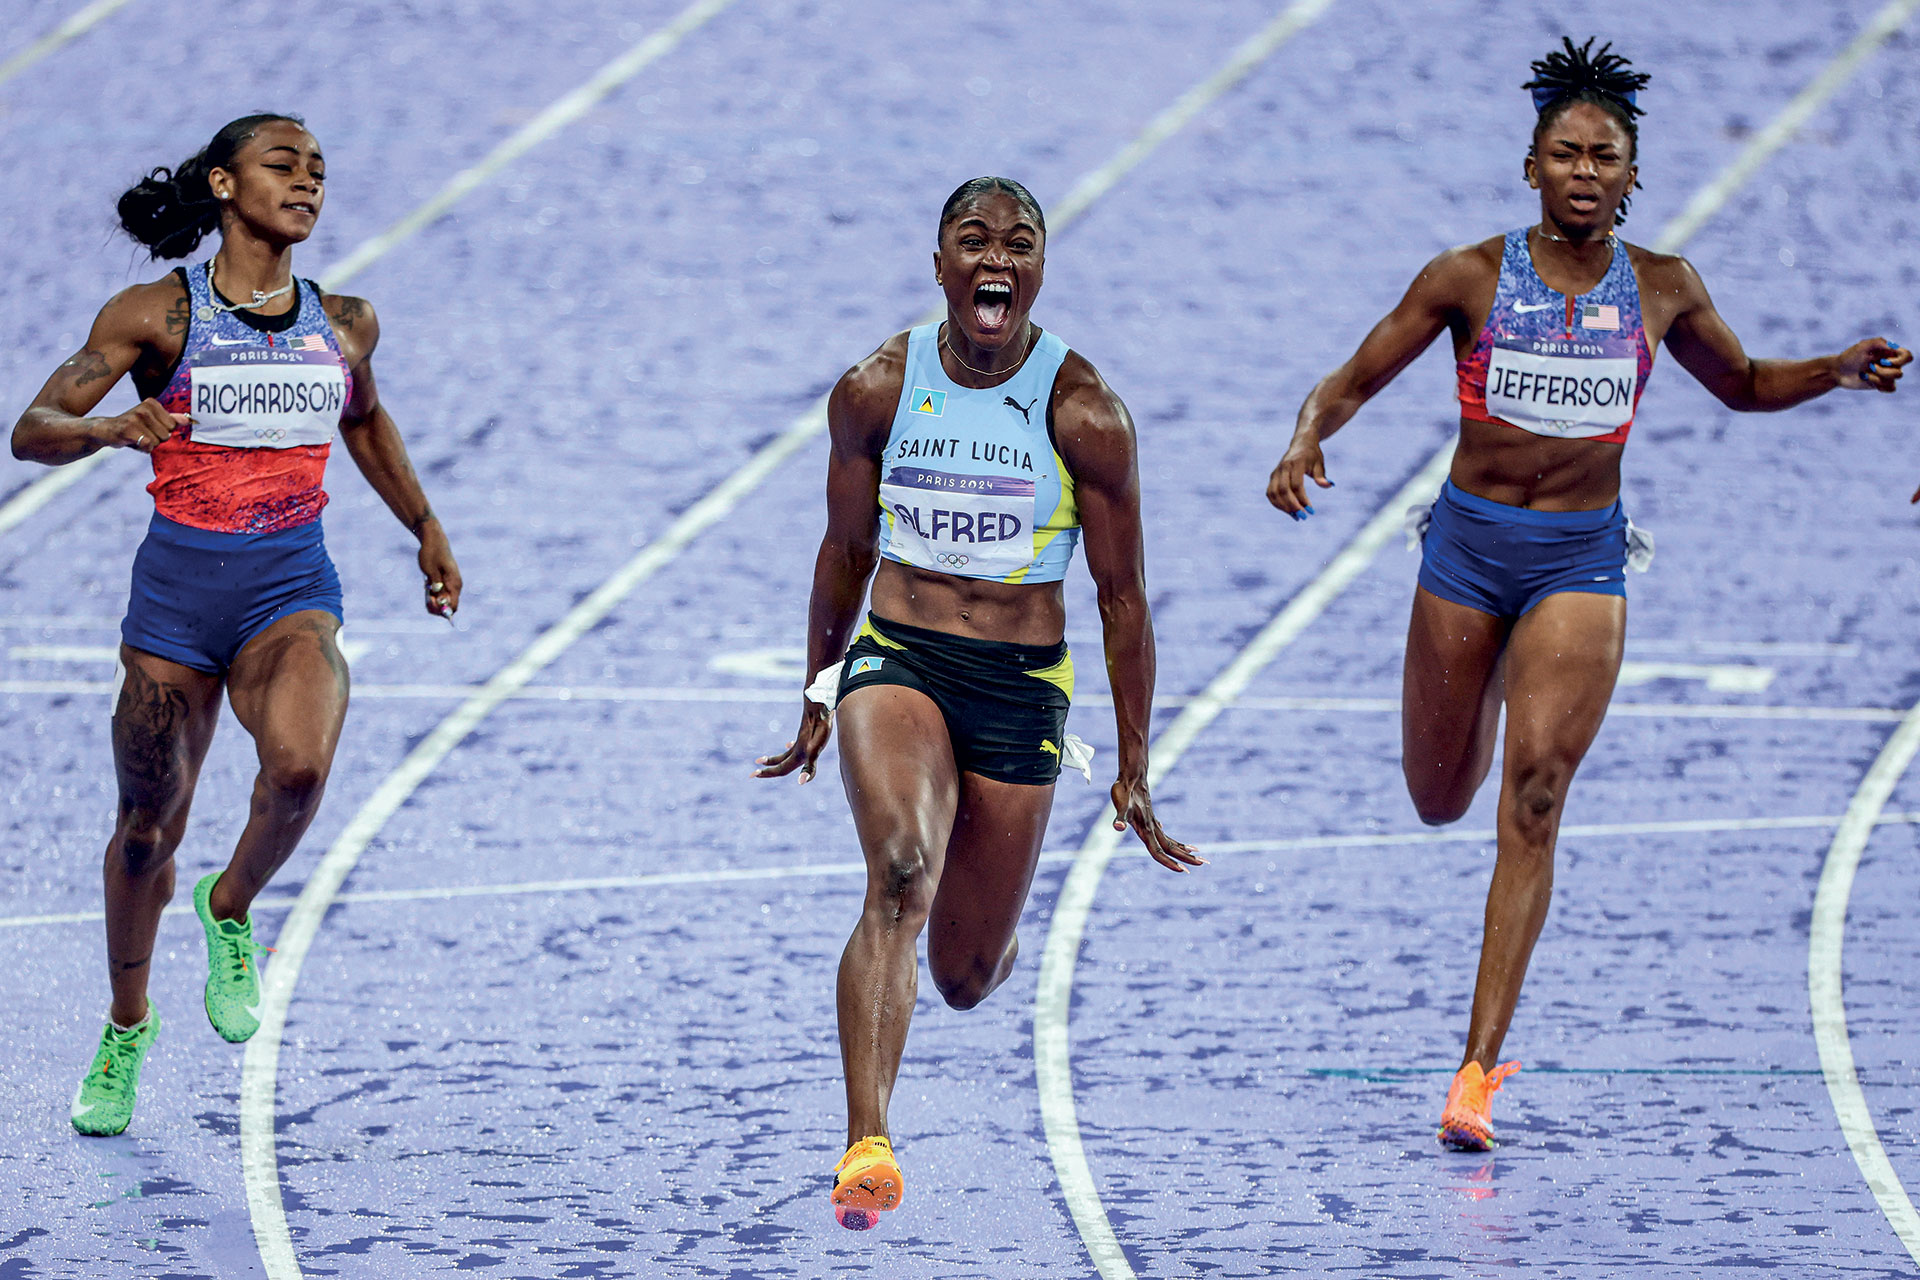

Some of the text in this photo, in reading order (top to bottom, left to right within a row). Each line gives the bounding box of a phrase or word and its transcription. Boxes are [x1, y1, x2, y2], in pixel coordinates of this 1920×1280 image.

[230, 350, 304, 362] PARIS 2024
[1532, 341, 1604, 356] PARIS 2024
[197, 381, 341, 415] RICHARDSON
[1491, 367, 1632, 407] JEFFERSON
[897, 438, 1034, 472] SAINT LUCIA
[917, 473, 994, 490] PARIS 2024
[894, 503, 1022, 543] ALFRED
